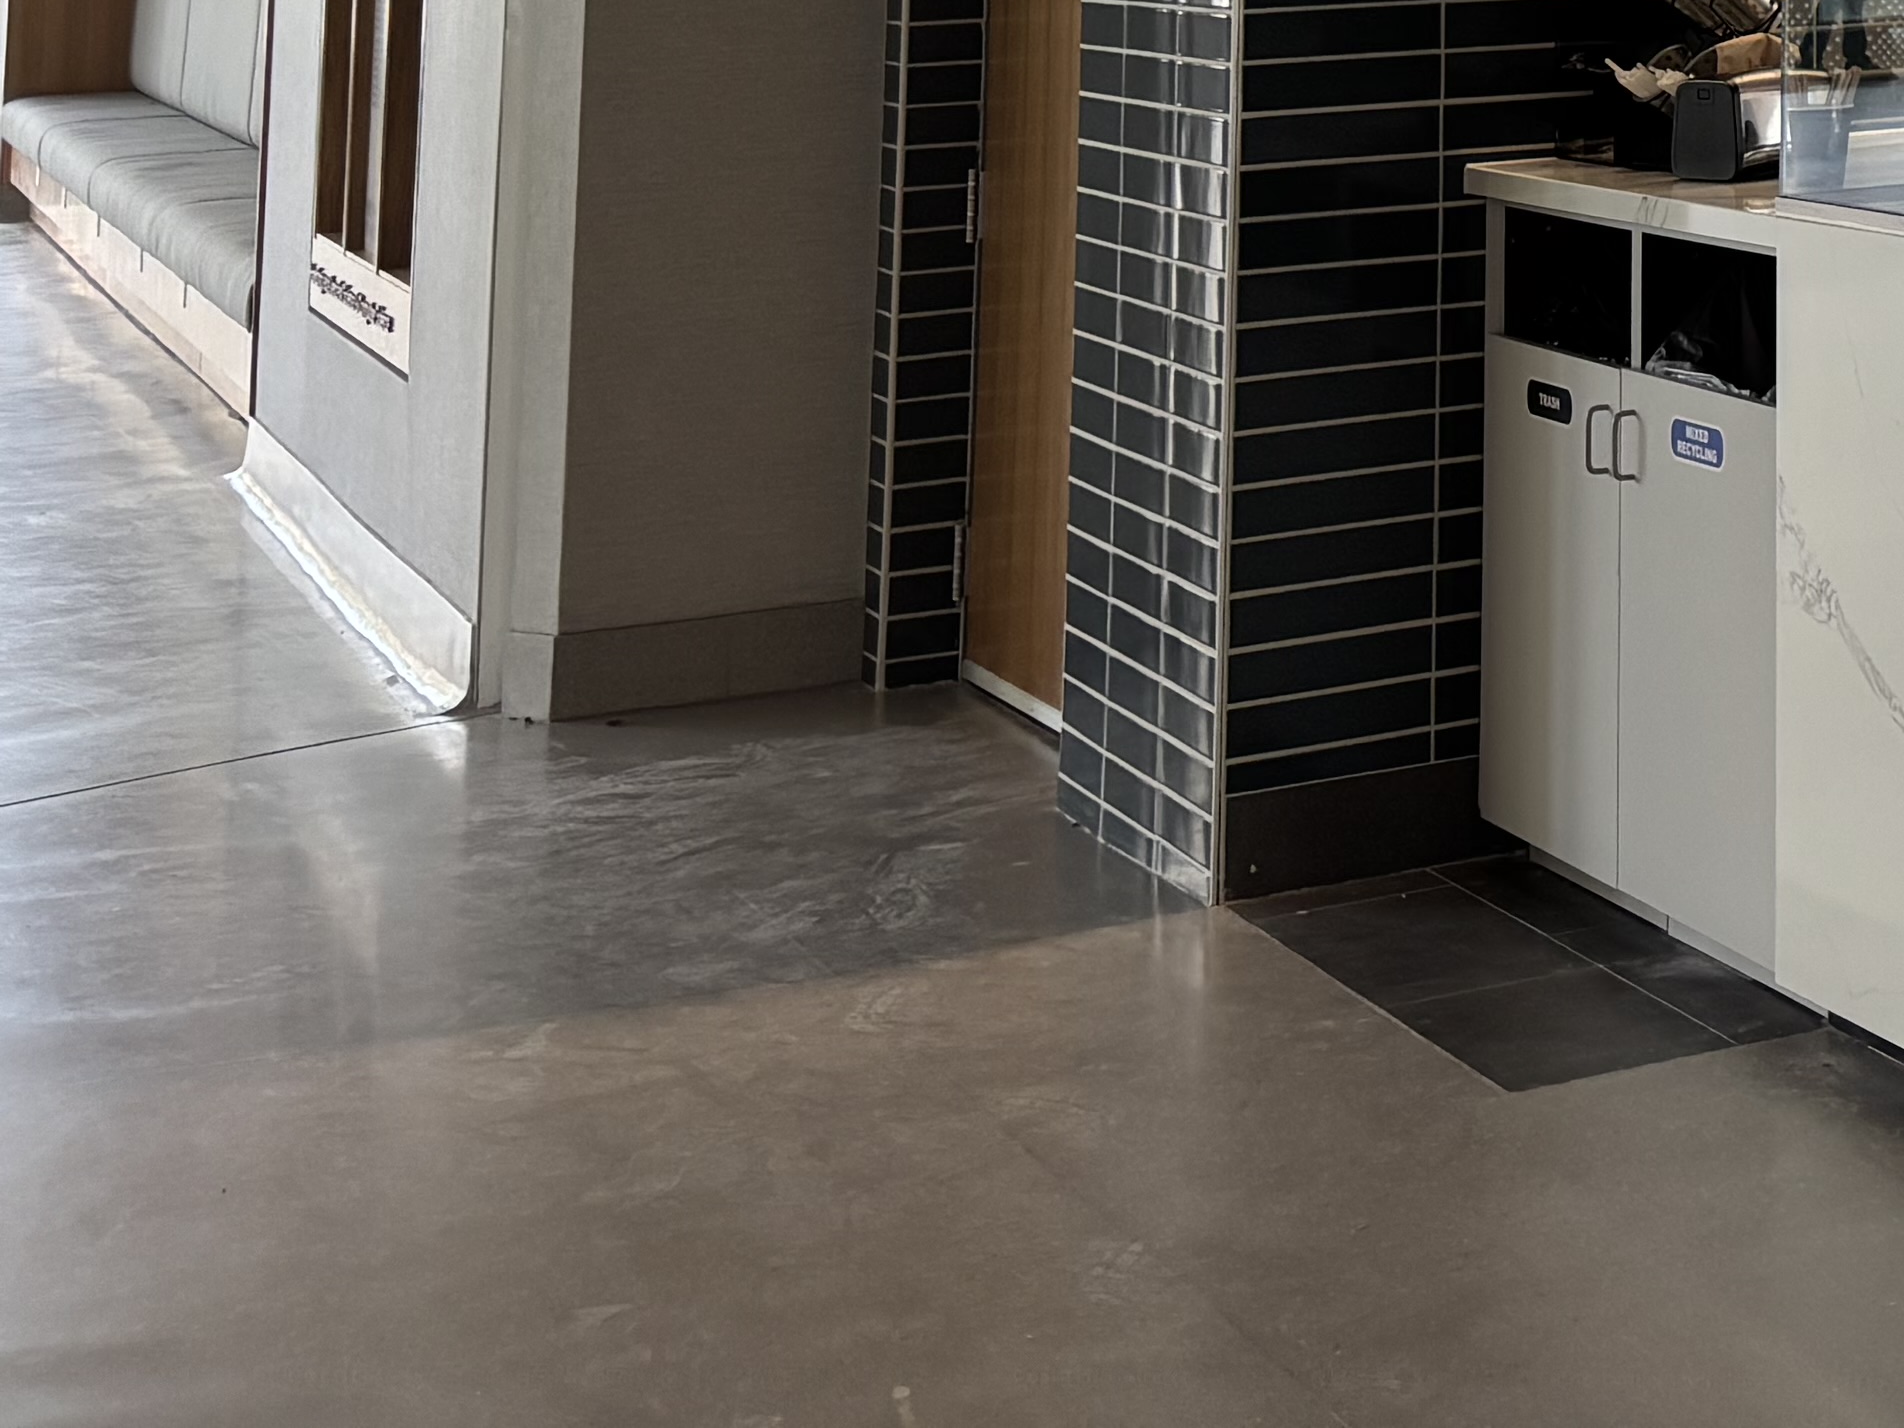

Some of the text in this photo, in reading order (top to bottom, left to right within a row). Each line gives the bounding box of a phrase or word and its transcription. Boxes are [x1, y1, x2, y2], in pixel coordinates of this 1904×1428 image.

[1539, 393, 1560, 410] TRASH
[1685, 425, 1709, 443] MIXED
[1677, 440, 1717, 464] RECYCLING
